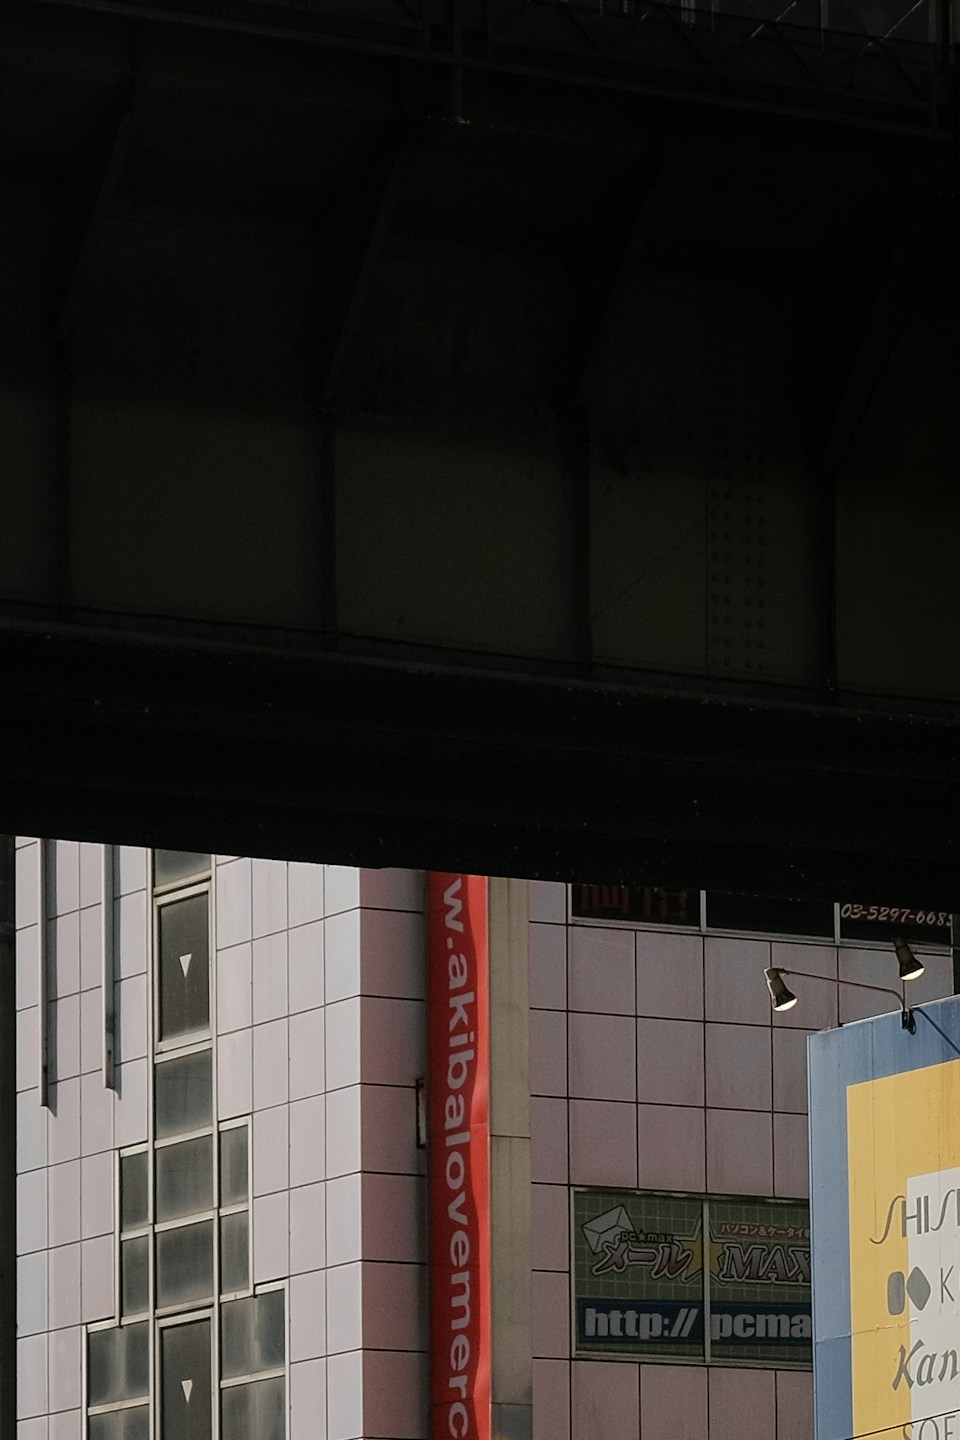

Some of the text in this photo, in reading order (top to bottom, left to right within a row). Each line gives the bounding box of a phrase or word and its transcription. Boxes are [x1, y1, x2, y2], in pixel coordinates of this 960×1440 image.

[593, 1242, 692, 1276] メール
[584, 1307, 699, 1340] http://
